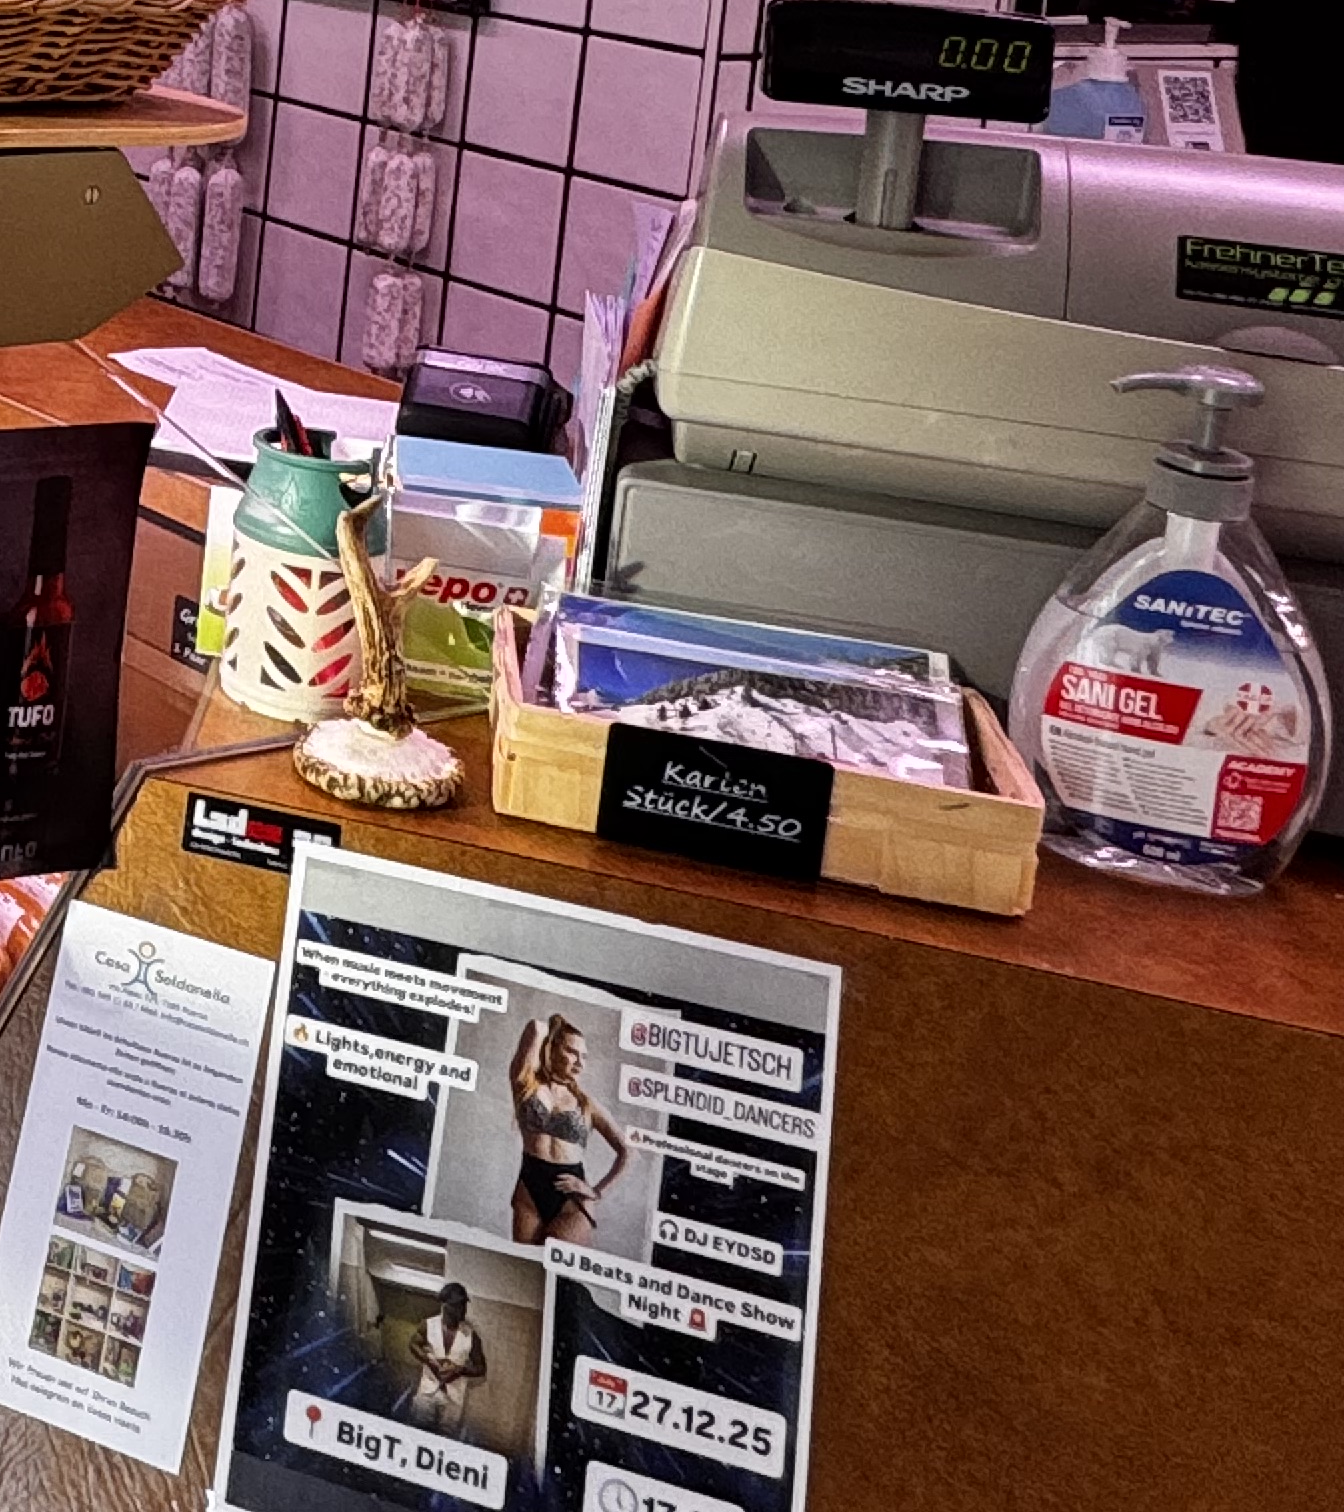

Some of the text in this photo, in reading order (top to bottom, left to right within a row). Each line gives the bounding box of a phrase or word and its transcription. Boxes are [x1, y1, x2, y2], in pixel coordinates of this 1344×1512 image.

[938, 36, 1032, 74] 0.00
[842, 76, 971, 103] SHARP
[8, 704, 55, 728] TUFO
[1061, 674, 1116, 710] SANI
[1119, 687, 1163, 722] GEL
[622, 785, 803, 838] Stück/4.50
[94, 950, 132, 973] Casa
[154, 969, 231, 1005] Soldanella
[302, 946, 504, 1006] When music meets movement
[331, 972, 477, 1016] everything explodes!
[315, 1029, 471, 1082] Lights,energy and
[332, 1057, 419, 1090] emotional
[630, 1022, 792, 1081] @BIGTUJETSCH
[627, 1076, 816, 1139] @SPLENDID_DANCERS
[642, 1133, 712, 1161] Professional
[684, 1227, 709, 1247] DJ
[550, 1248, 795, 1331] DJ Beats and Dance Show
[628, 1294, 682, 1322] Night
[629, 1390, 774, 1456] 27.12.25
[336, 1420, 490, 1491] BigT, Dieni
